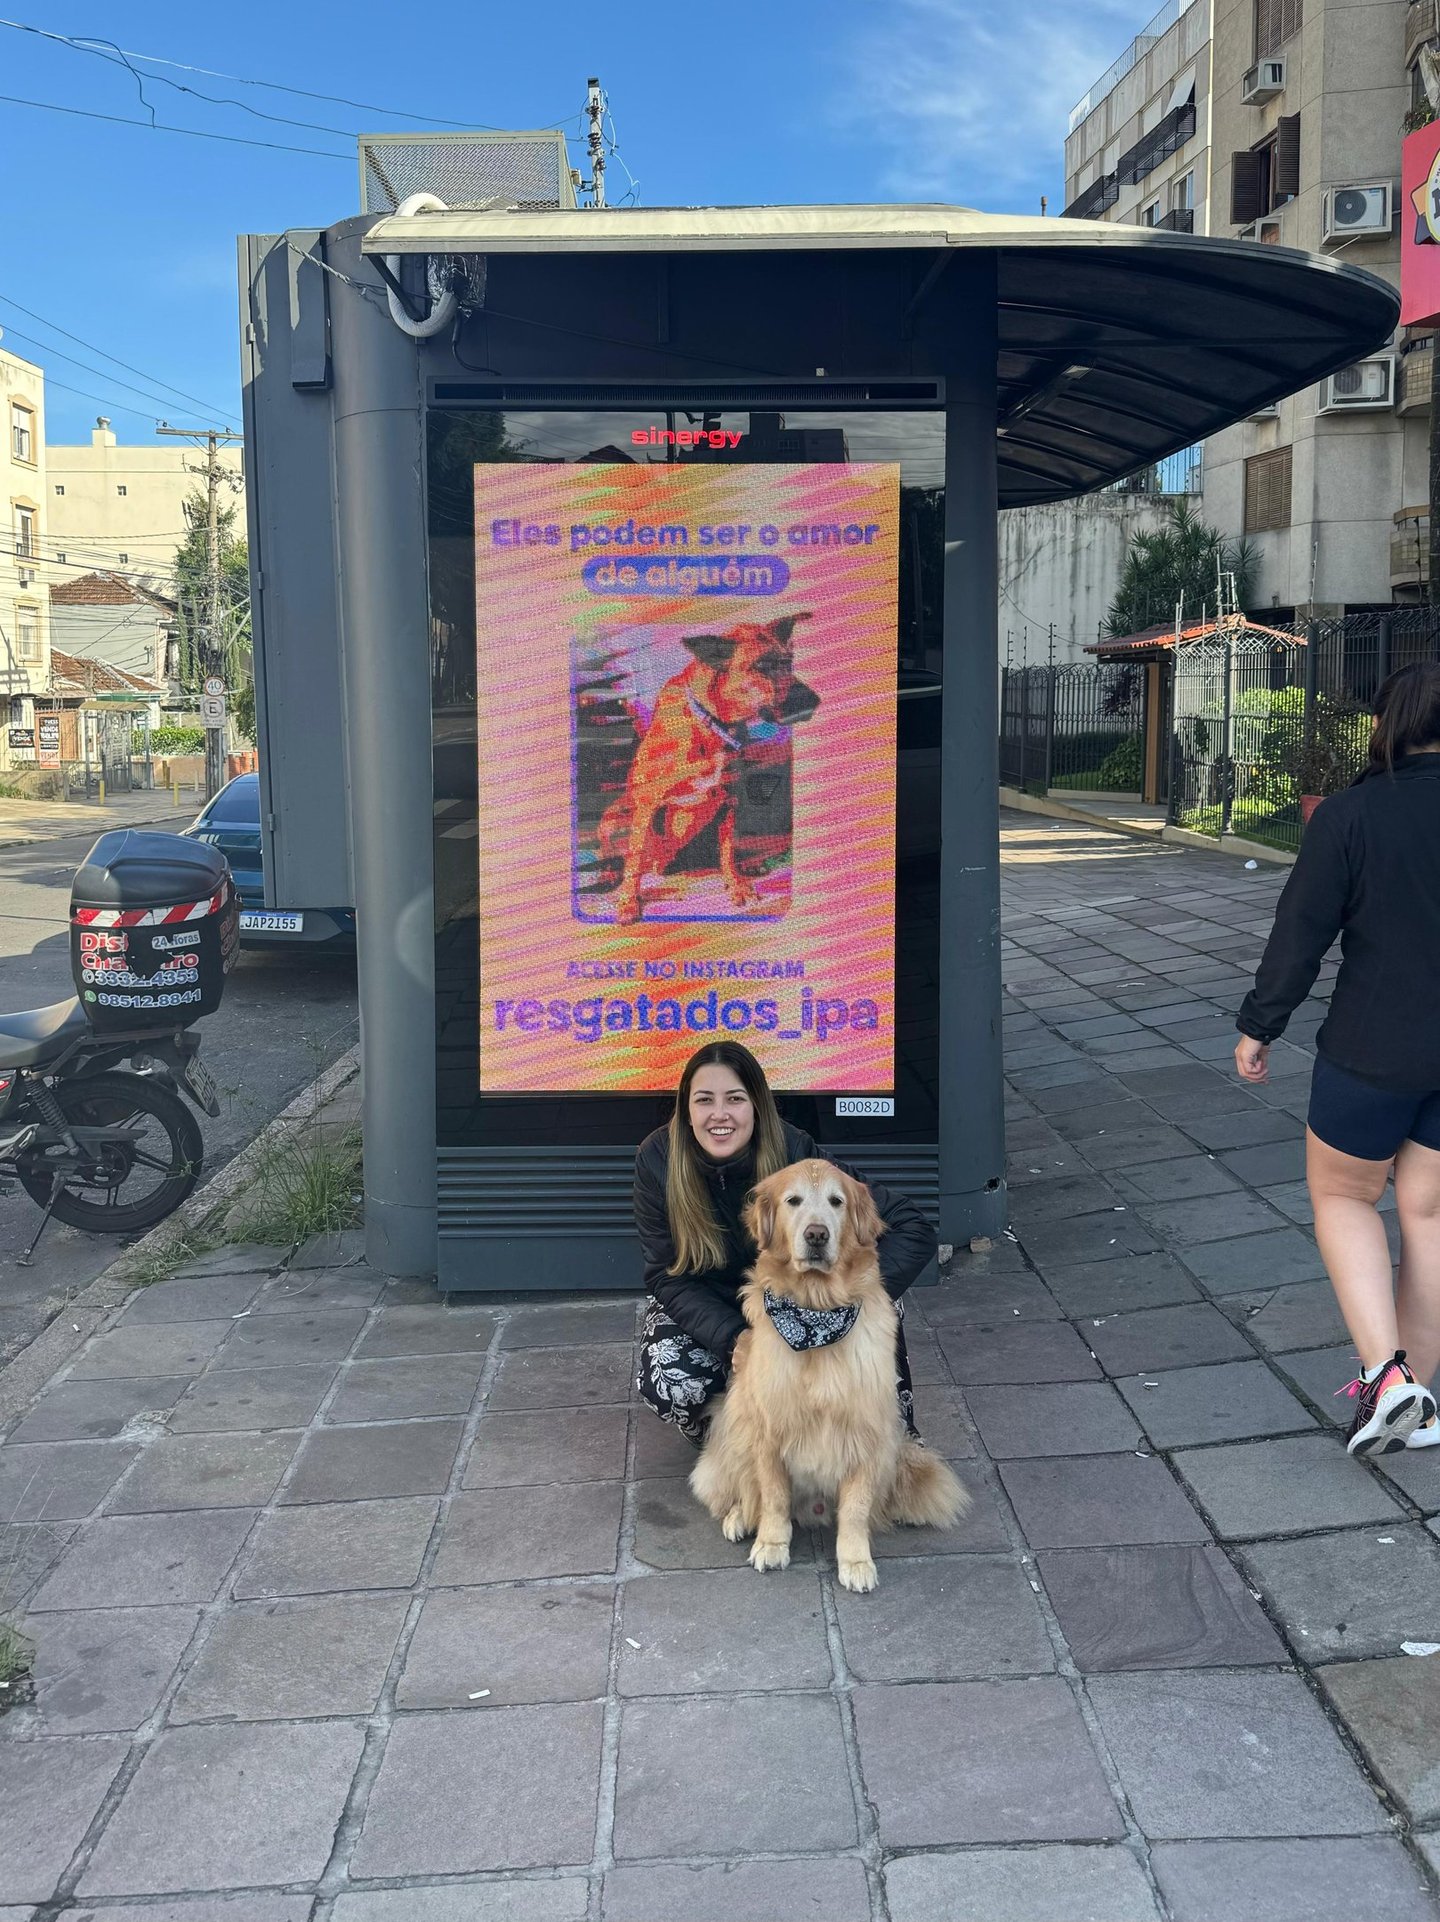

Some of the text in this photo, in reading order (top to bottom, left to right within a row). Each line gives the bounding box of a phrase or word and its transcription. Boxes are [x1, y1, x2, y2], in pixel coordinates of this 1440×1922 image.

[631, 426, 742, 449] sinergy
[492, 518, 879, 552] Eles podem ser o amor
[596, 558, 773, 595] de alguém
[208, 681, 221, 690] 40
[154, 937, 168, 948] 24
[565, 960, 805, 978] ACESSE NO INSTAGRAM
[98, 989, 201, 1008] 98512.8841
[494, 986, 878, 1042] resgatados_ipa
[839, 1101, 891, 1113] B0082D
